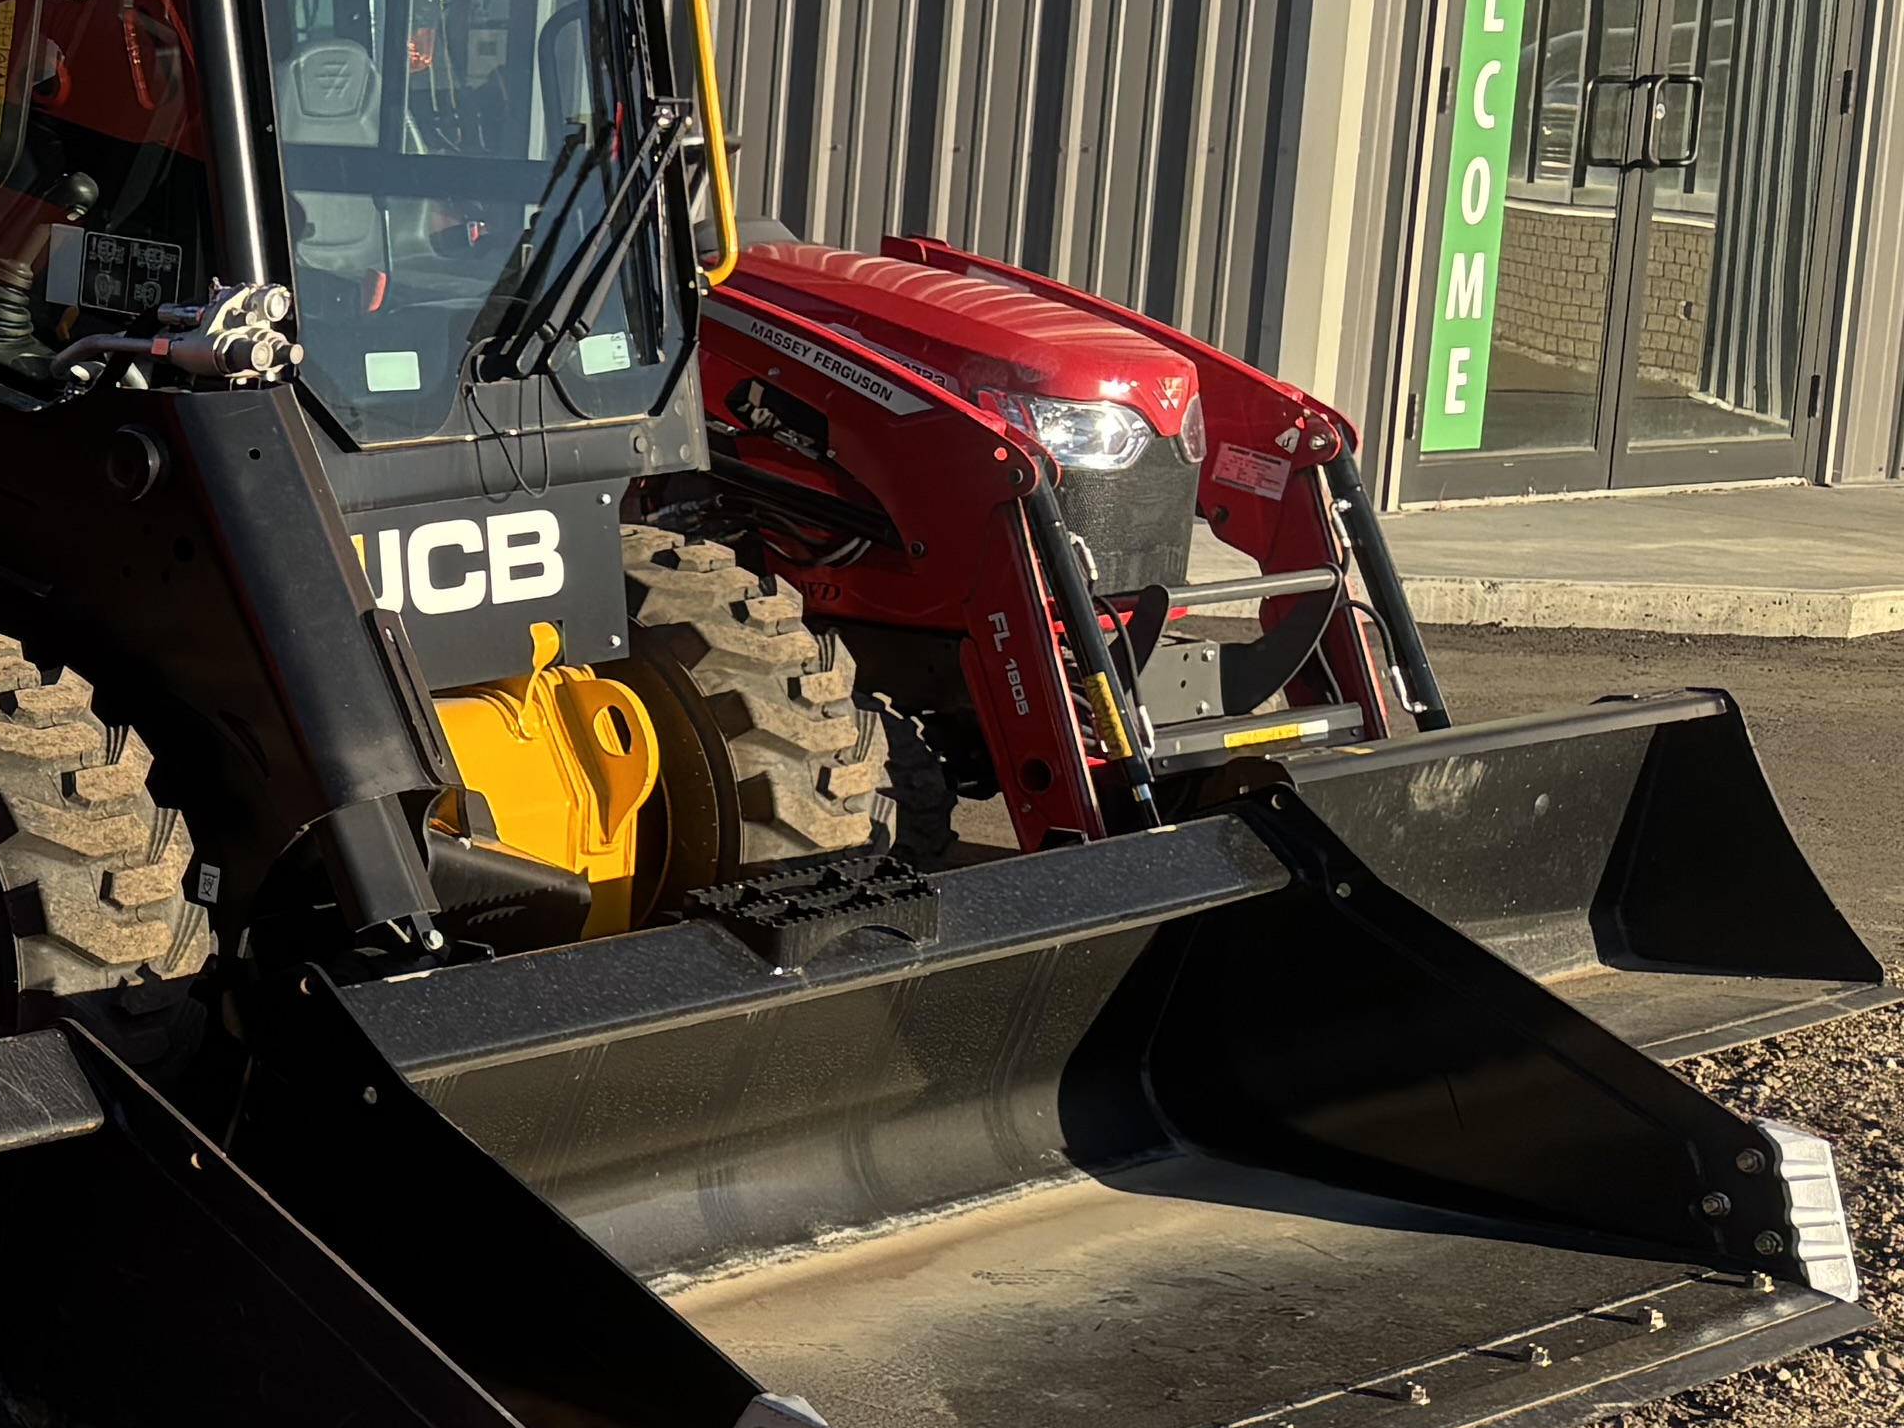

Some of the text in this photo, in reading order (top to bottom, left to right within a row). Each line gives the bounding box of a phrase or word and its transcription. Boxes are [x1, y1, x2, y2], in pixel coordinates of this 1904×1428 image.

[749, 320, 893, 403] MASSEY FERGUSON
[350, 509, 565, 615] JCB
[988, 611, 1011, 652] FL
[1004, 657, 1031, 717] 1805
